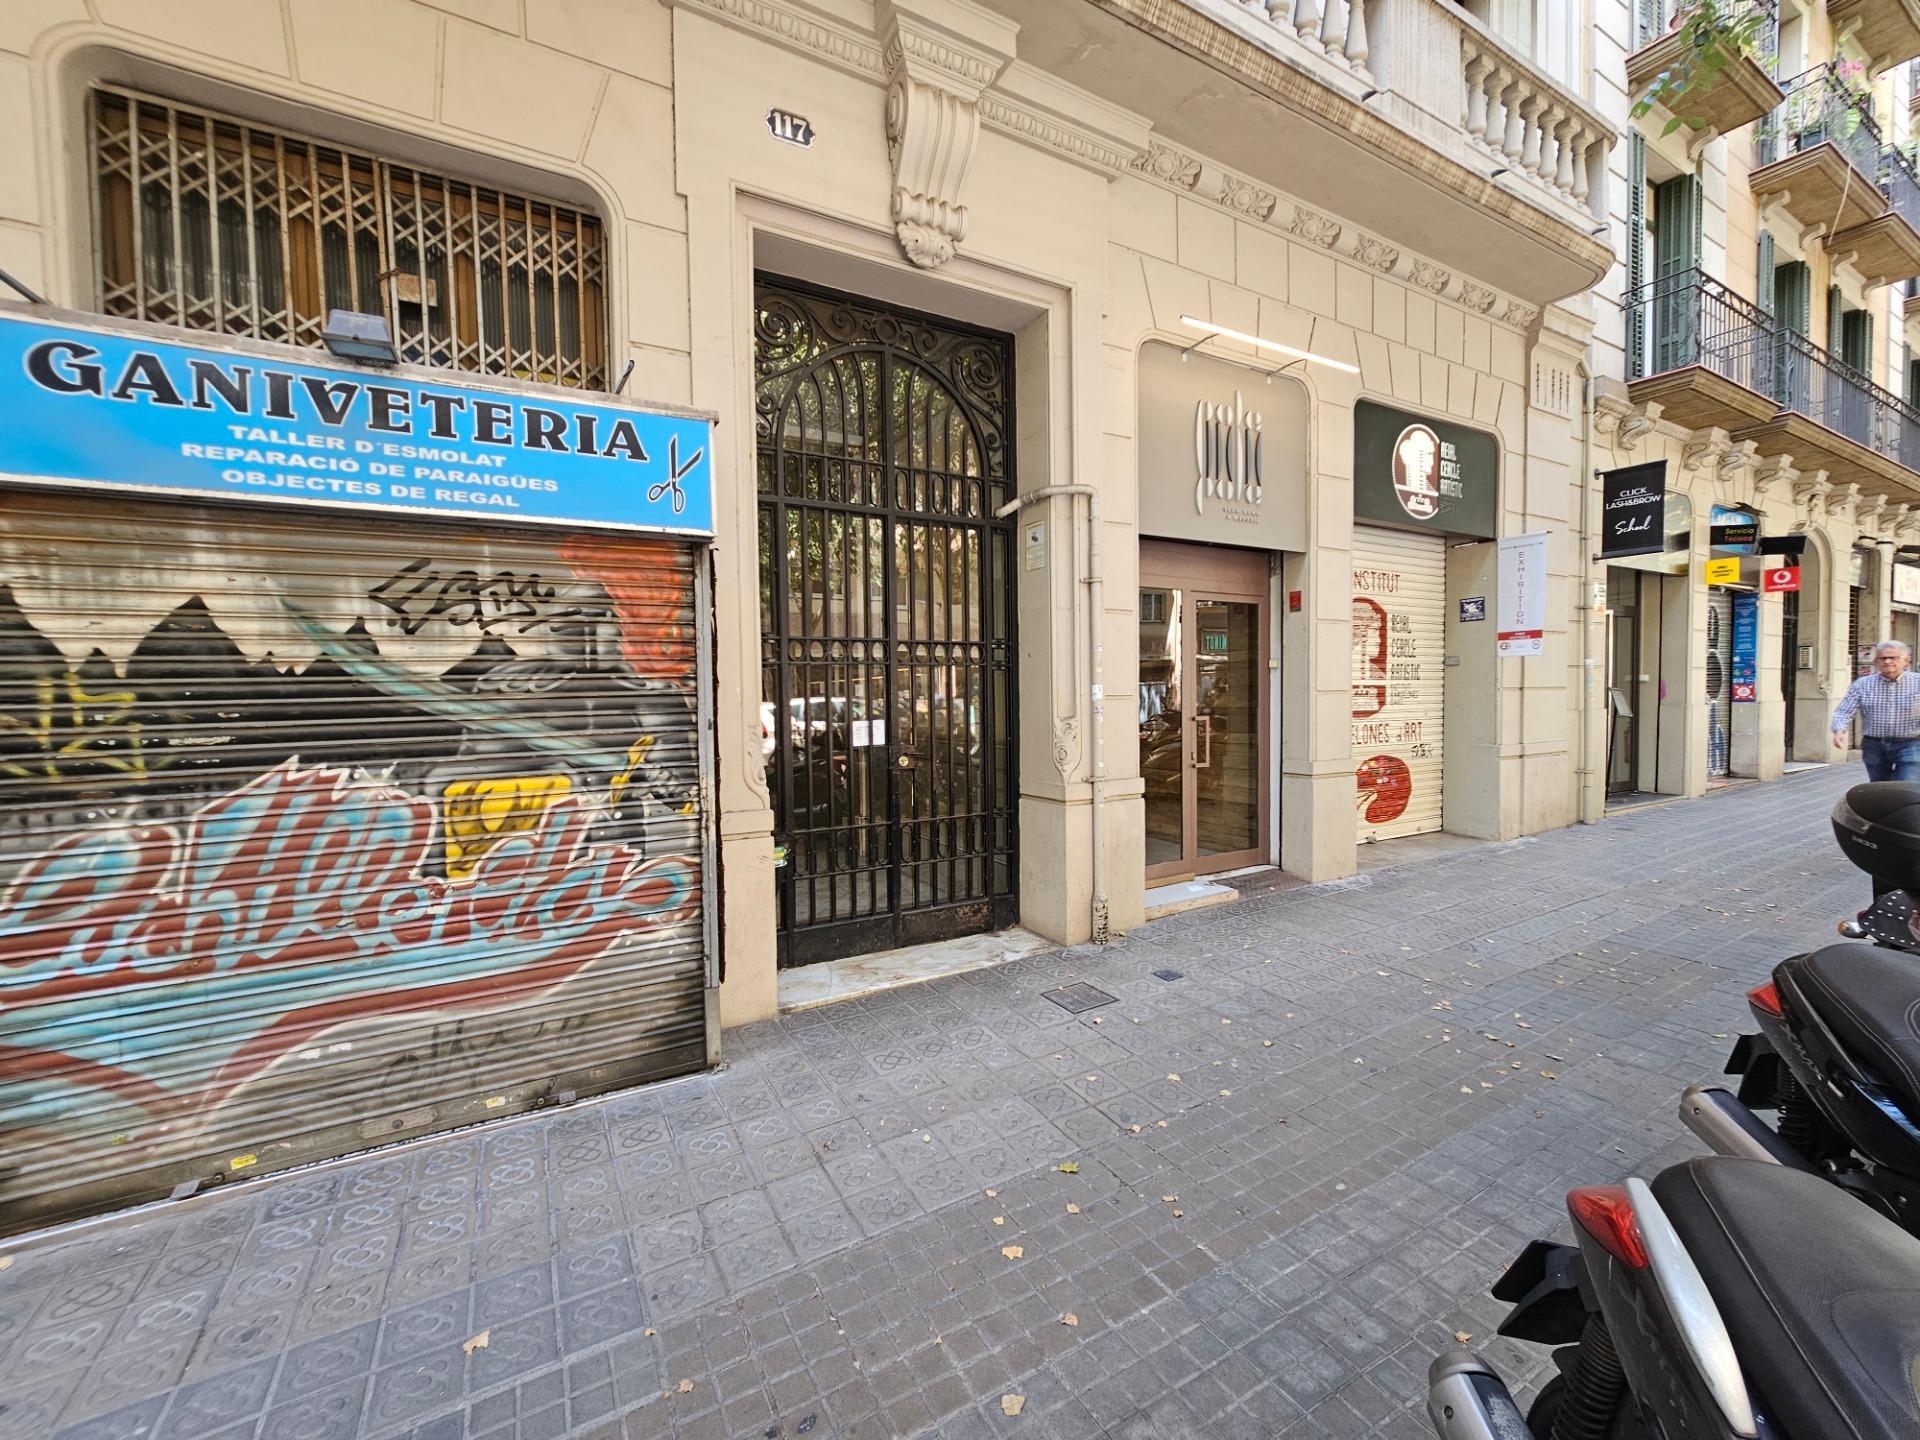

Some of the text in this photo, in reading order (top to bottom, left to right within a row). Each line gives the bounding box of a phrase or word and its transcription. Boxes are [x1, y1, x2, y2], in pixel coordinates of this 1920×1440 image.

[773, 111, 806, 143] 117
[27, 340, 648, 462] GANIVETERIA
[228, 424, 346, 451] TALLER
[181, 443, 559, 492] REPARACIÓ DE PARAIGÜES
[1440, 460, 1460, 479] CERCLE
[222, 469, 520, 507] OBJECTES DE REGAL
[1620, 486, 1647, 497] CLICK
[1606, 494, 1662, 510] LASH&BROW
[1615, 515, 1652, 535] School
[1516, 551, 1525, 625] EXHIBITION
[1391, 638, 1416, 658] CERCLE
